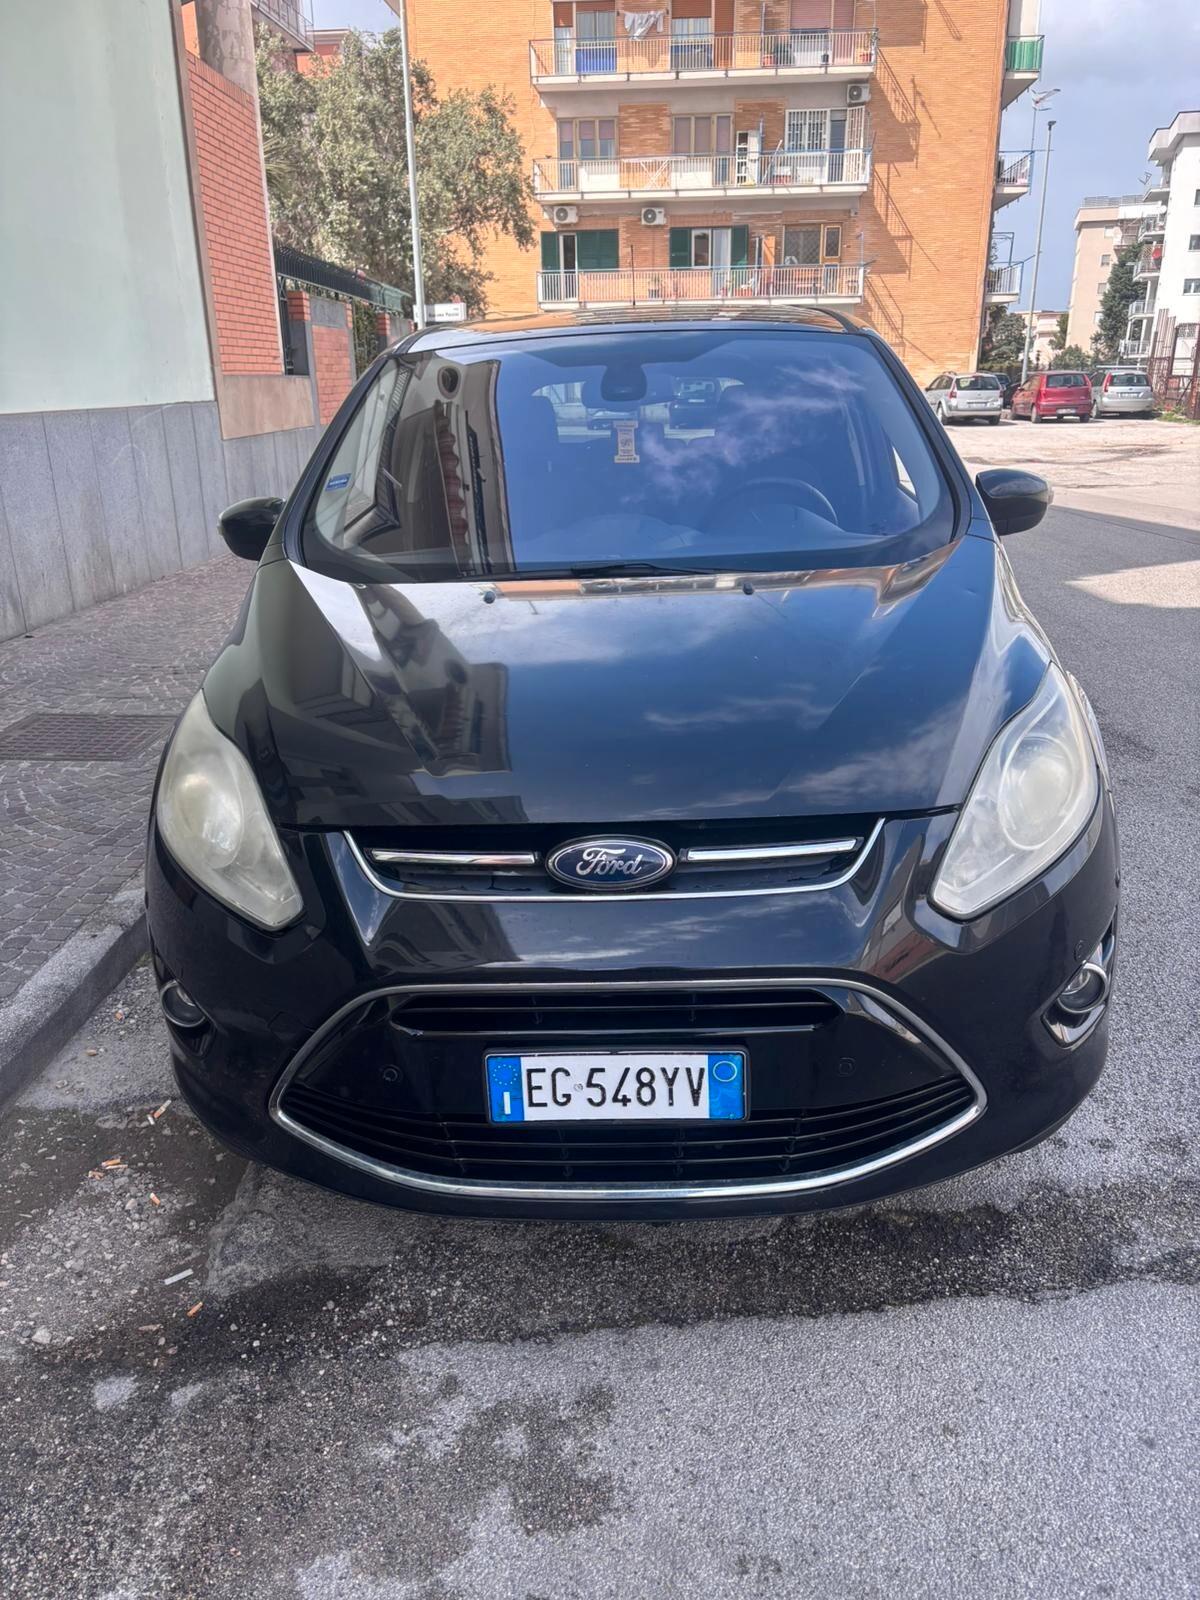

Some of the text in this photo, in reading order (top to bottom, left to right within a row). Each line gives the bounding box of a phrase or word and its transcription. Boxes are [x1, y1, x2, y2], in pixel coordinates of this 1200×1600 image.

[576, 847, 643, 876] Ford
[526, 1066, 705, 1108] EG 548YV
